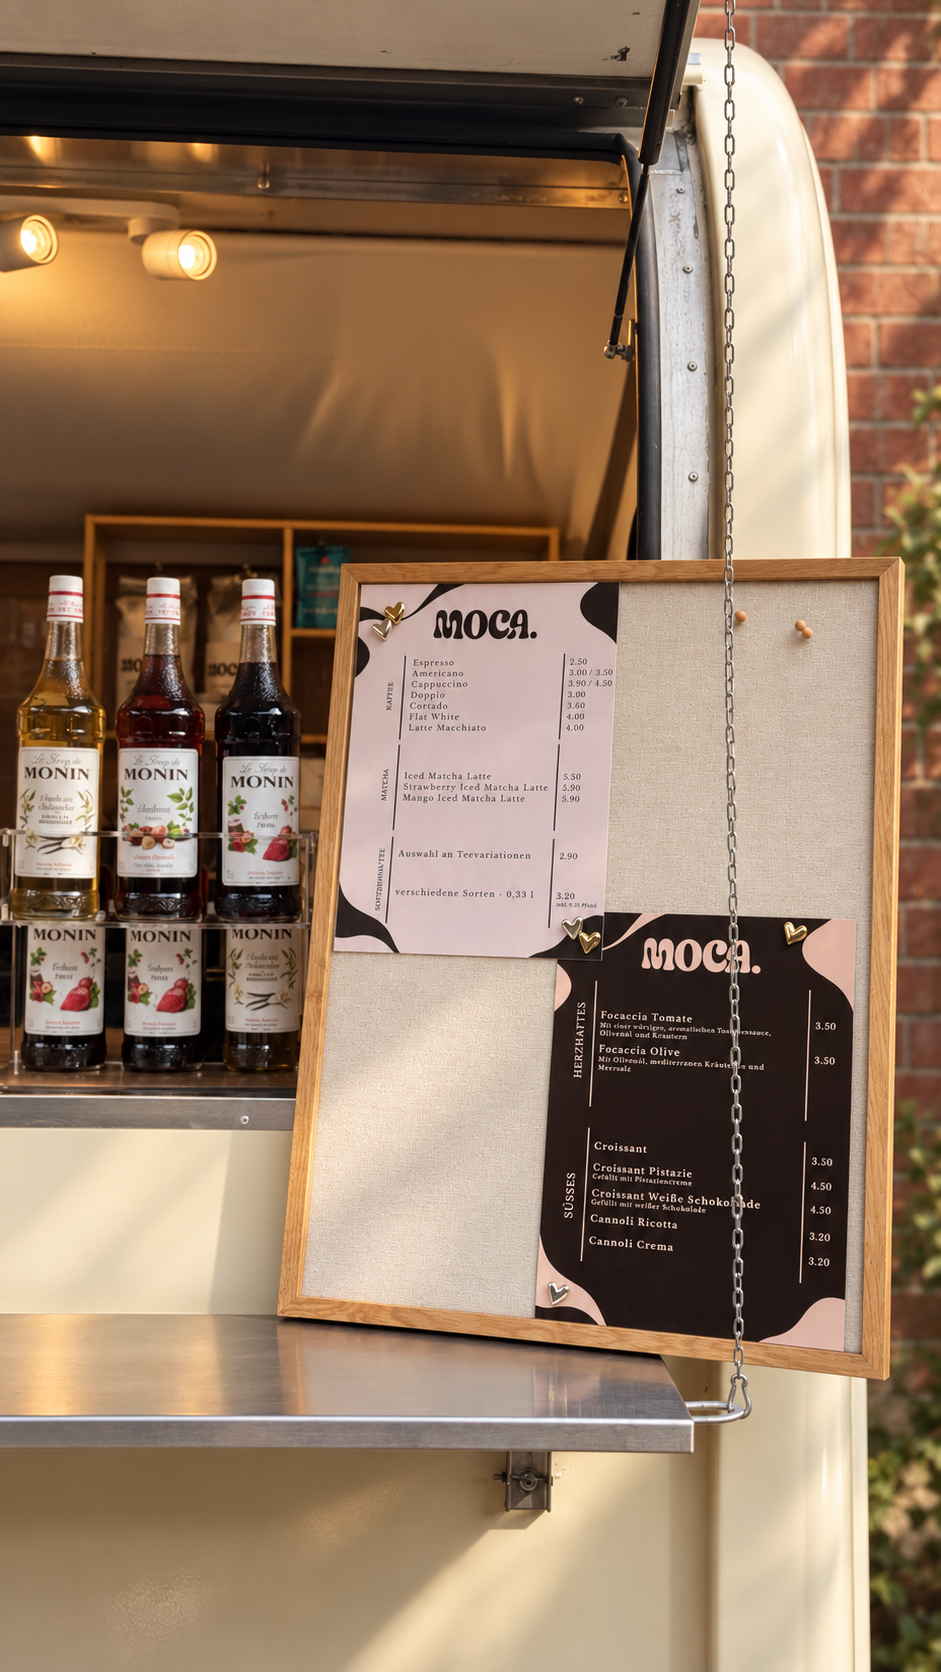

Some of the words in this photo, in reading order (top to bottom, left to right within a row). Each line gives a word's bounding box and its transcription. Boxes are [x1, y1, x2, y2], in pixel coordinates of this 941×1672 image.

[434, 610, 537, 639] MOCA.
[413, 659, 454, 668] Espresso
[208, 663, 238, 676] MOC
[411, 681, 468, 690] Cappuccino
[410, 691, 445, 700] Doppio
[408, 724, 433, 732] Latte
[436, 724, 487, 732] Macchiato
[24, 766, 90, 780] MONIN
[124, 768, 188, 781] MONIN
[404, 772, 424, 780] Iced
[231, 775, 294, 788] MONIN
[403, 783, 456, 792] Strawberry
[402, 794, 434, 804] Mango
[437, 794, 458, 802] Iced
[461, 794, 496, 803] Matcha
[398, 850, 438, 858] Auswahl
[457, 850, 531, 860] Teevariationen
[559, 852, 578, 860] 2.90
[395, 888, 459, 898] verschiedene
[462, 890, 495, 898] Sorten
[34, 928, 97, 941] MONIN
[131, 930, 192, 943] MONIN
[232, 928, 292, 940] MONIN
[641, 937, 761, 974] MOCA.
[600, 1010, 648, 1021] Focaccia
[651, 1012, 693, 1024] Tomate
[815, 1021, 837, 1031] 3.50
[599, 1044, 646, 1055] Focaccia
[650, 1046, 680, 1057] Olive
[814, 1056, 836, 1066] 3.50
[594, 1141, 648, 1154] Croissant
[811, 1157, 833, 1167] 3.50
[593, 1162, 645, 1175] Croissant
[649, 1166, 693, 1179] Pistazie
[810, 1182, 832, 1191] 4.50
[562, 1172, 576, 1219] SÜSSES
[591, 1188, 645, 1201] Croissant
[648, 1192, 684, 1204] Weiße
[687, 1195, 761, 1209] Schokoade
[810, 1205, 832, 1215] 4.50
[590, 1214, 634, 1226] Cannoli
[638, 1218, 678, 1230] Ricotta
[809, 1232, 831, 1242] 3.20
[589, 1236, 633, 1248] Cannoli
[636, 1240, 674, 1252] Crema
[808, 1257, 830, 1267] 3.20
